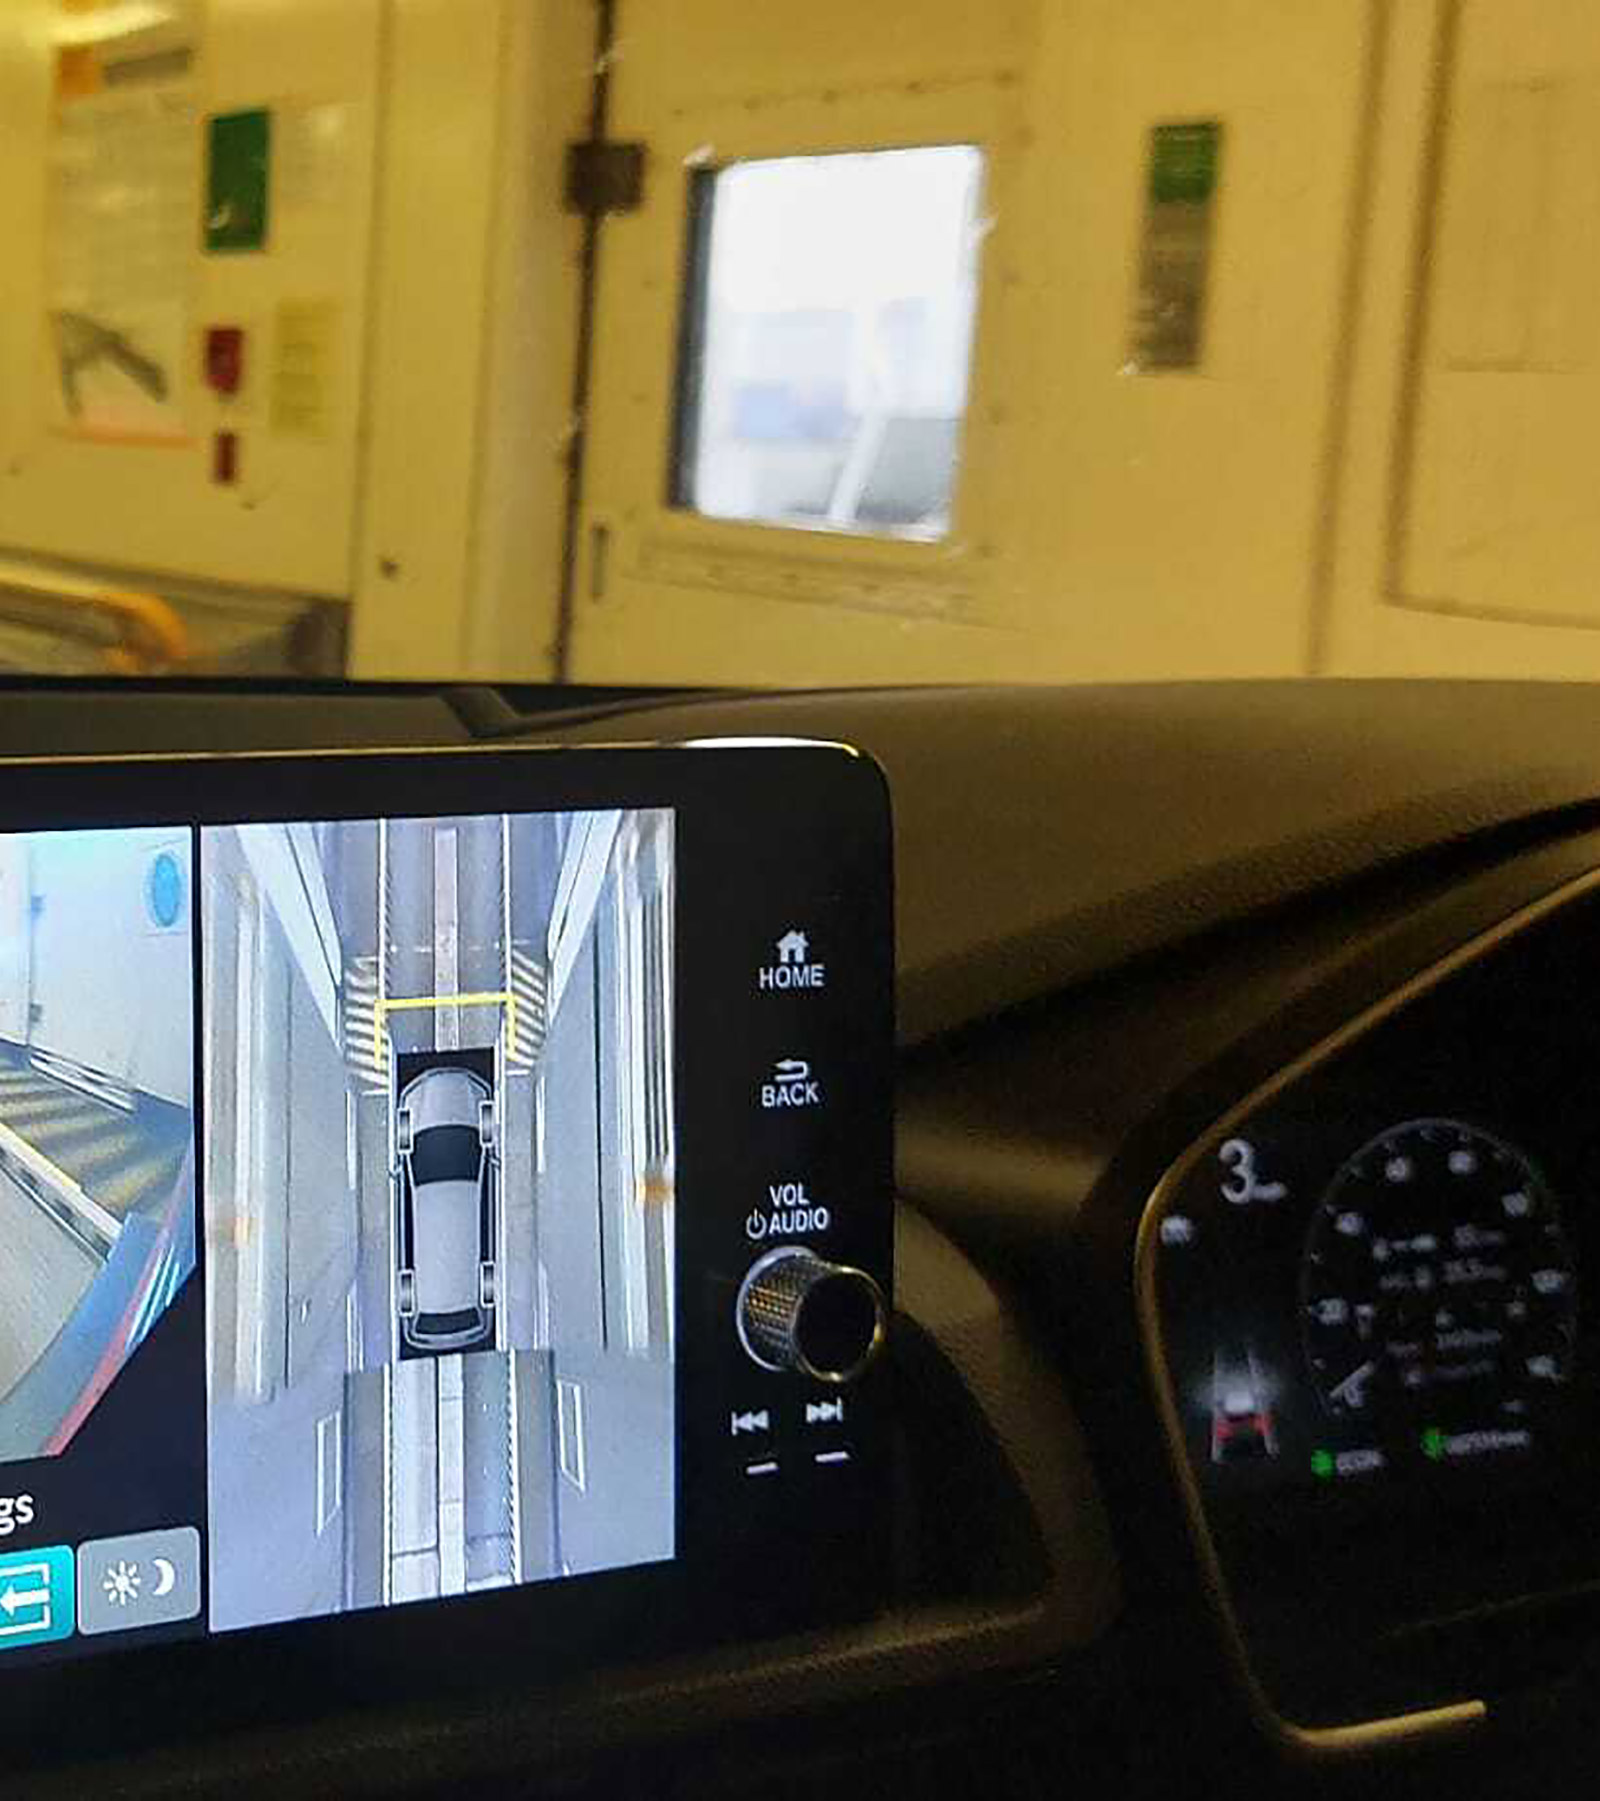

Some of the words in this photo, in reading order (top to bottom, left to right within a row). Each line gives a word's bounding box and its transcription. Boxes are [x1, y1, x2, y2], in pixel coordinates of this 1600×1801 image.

[758, 964, 825, 989] HOME
[761, 1082, 820, 1108] BACK
[769, 1182, 810, 1207] VOL
[768, 1206, 830, 1235] AUDIO
